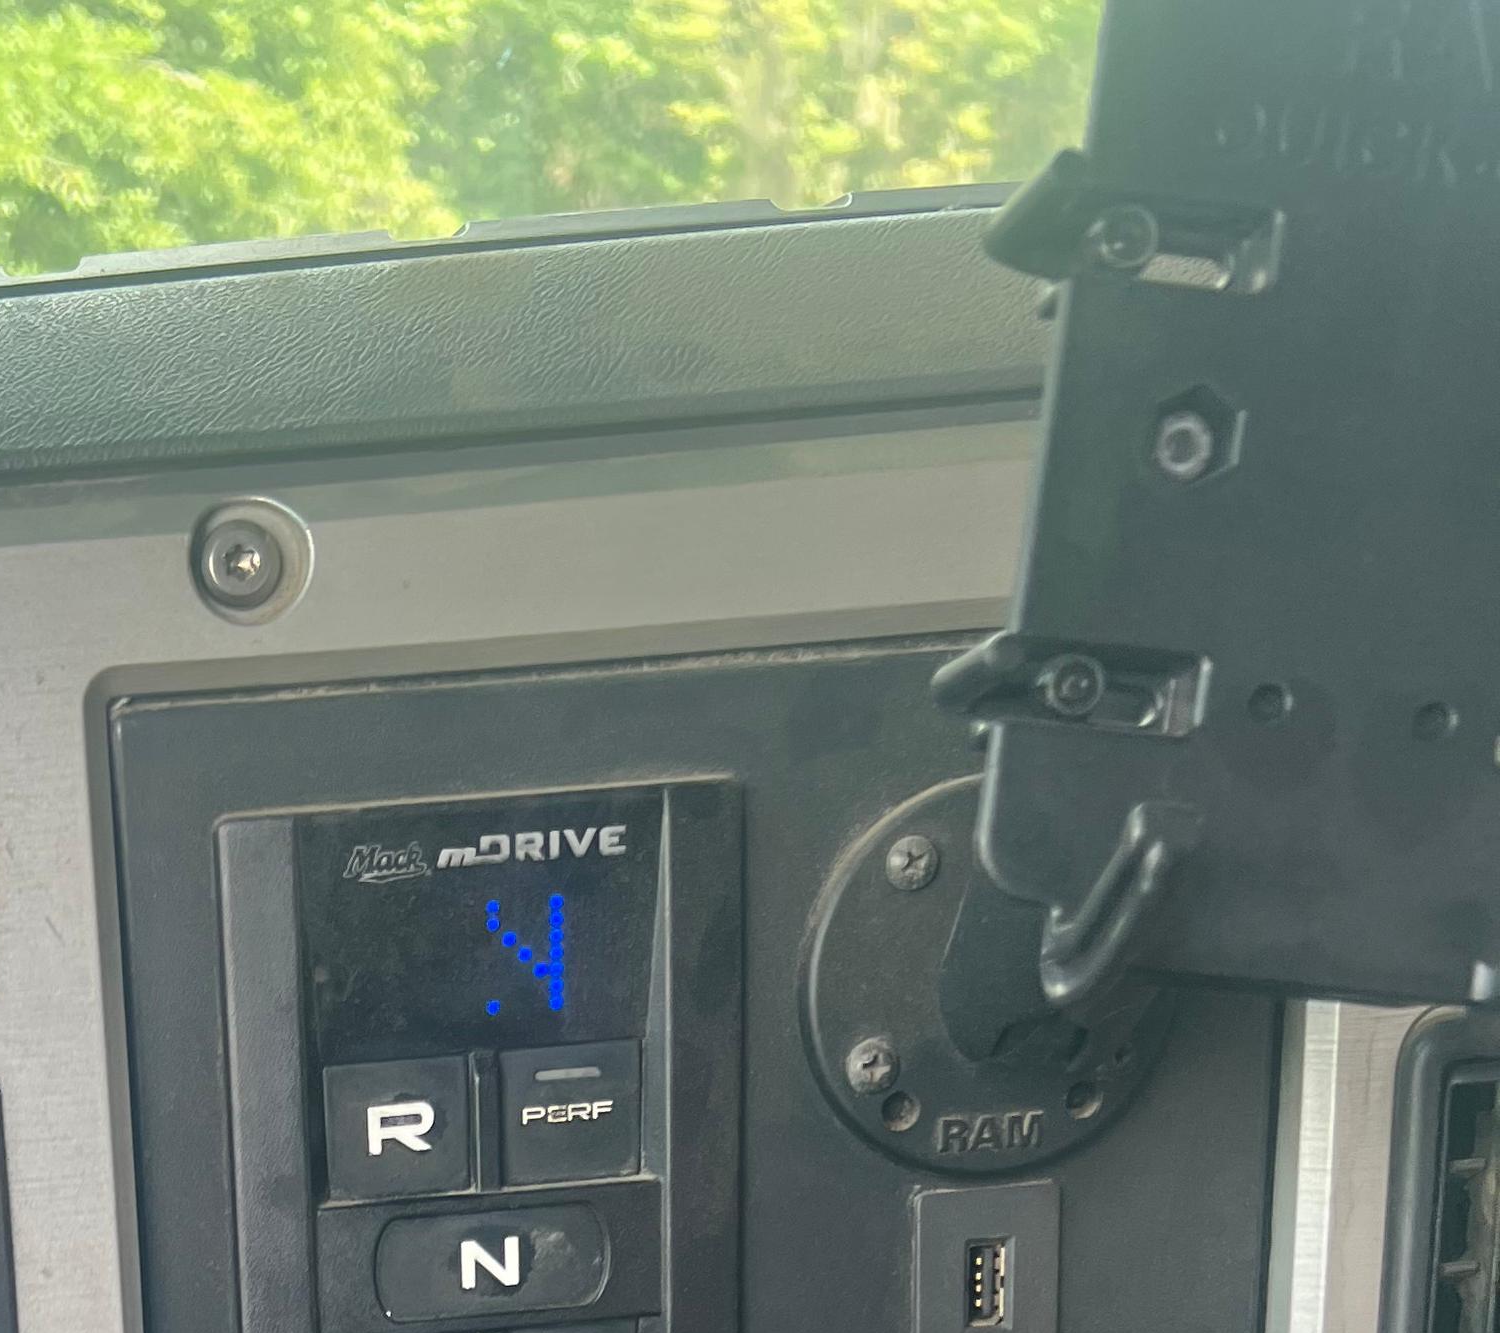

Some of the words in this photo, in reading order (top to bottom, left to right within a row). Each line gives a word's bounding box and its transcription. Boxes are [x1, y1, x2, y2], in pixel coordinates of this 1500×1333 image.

[436, 824, 627, 870] mDRIVE
[366, 1100, 436, 1156] R
[520, 1100, 614, 1126] PERF
[935, 1109, 1045, 1155] RAM
[460, 1235, 521, 1290] N
